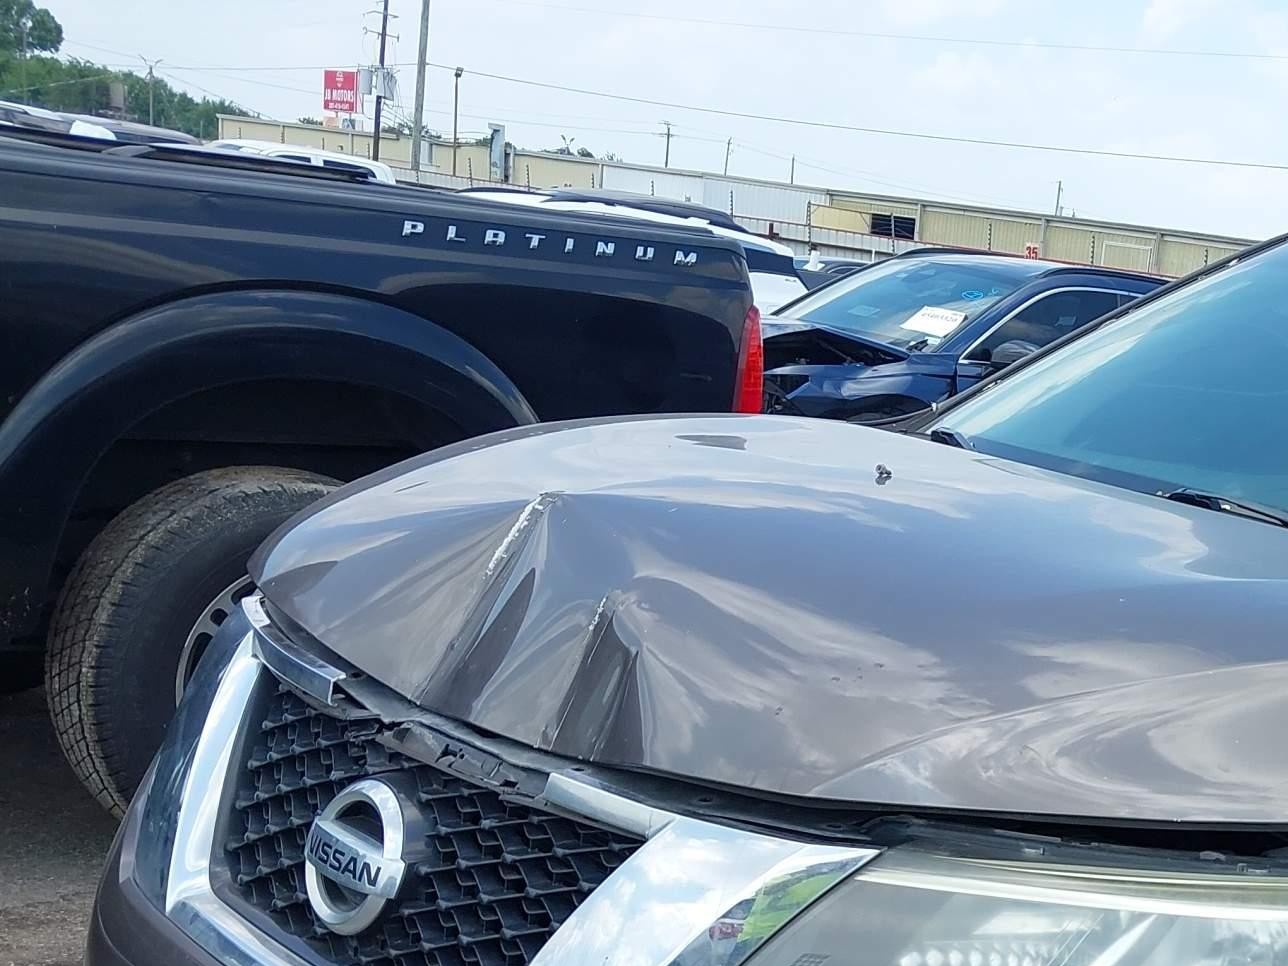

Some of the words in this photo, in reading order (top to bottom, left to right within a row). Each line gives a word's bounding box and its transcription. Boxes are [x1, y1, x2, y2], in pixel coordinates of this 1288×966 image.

[332, 88, 354, 102] MOTORS
[402, 220, 698, 266] PLATINUM
[1025, 246, 1038, 260] 35
[309, 834, 382, 888] NISSAN
